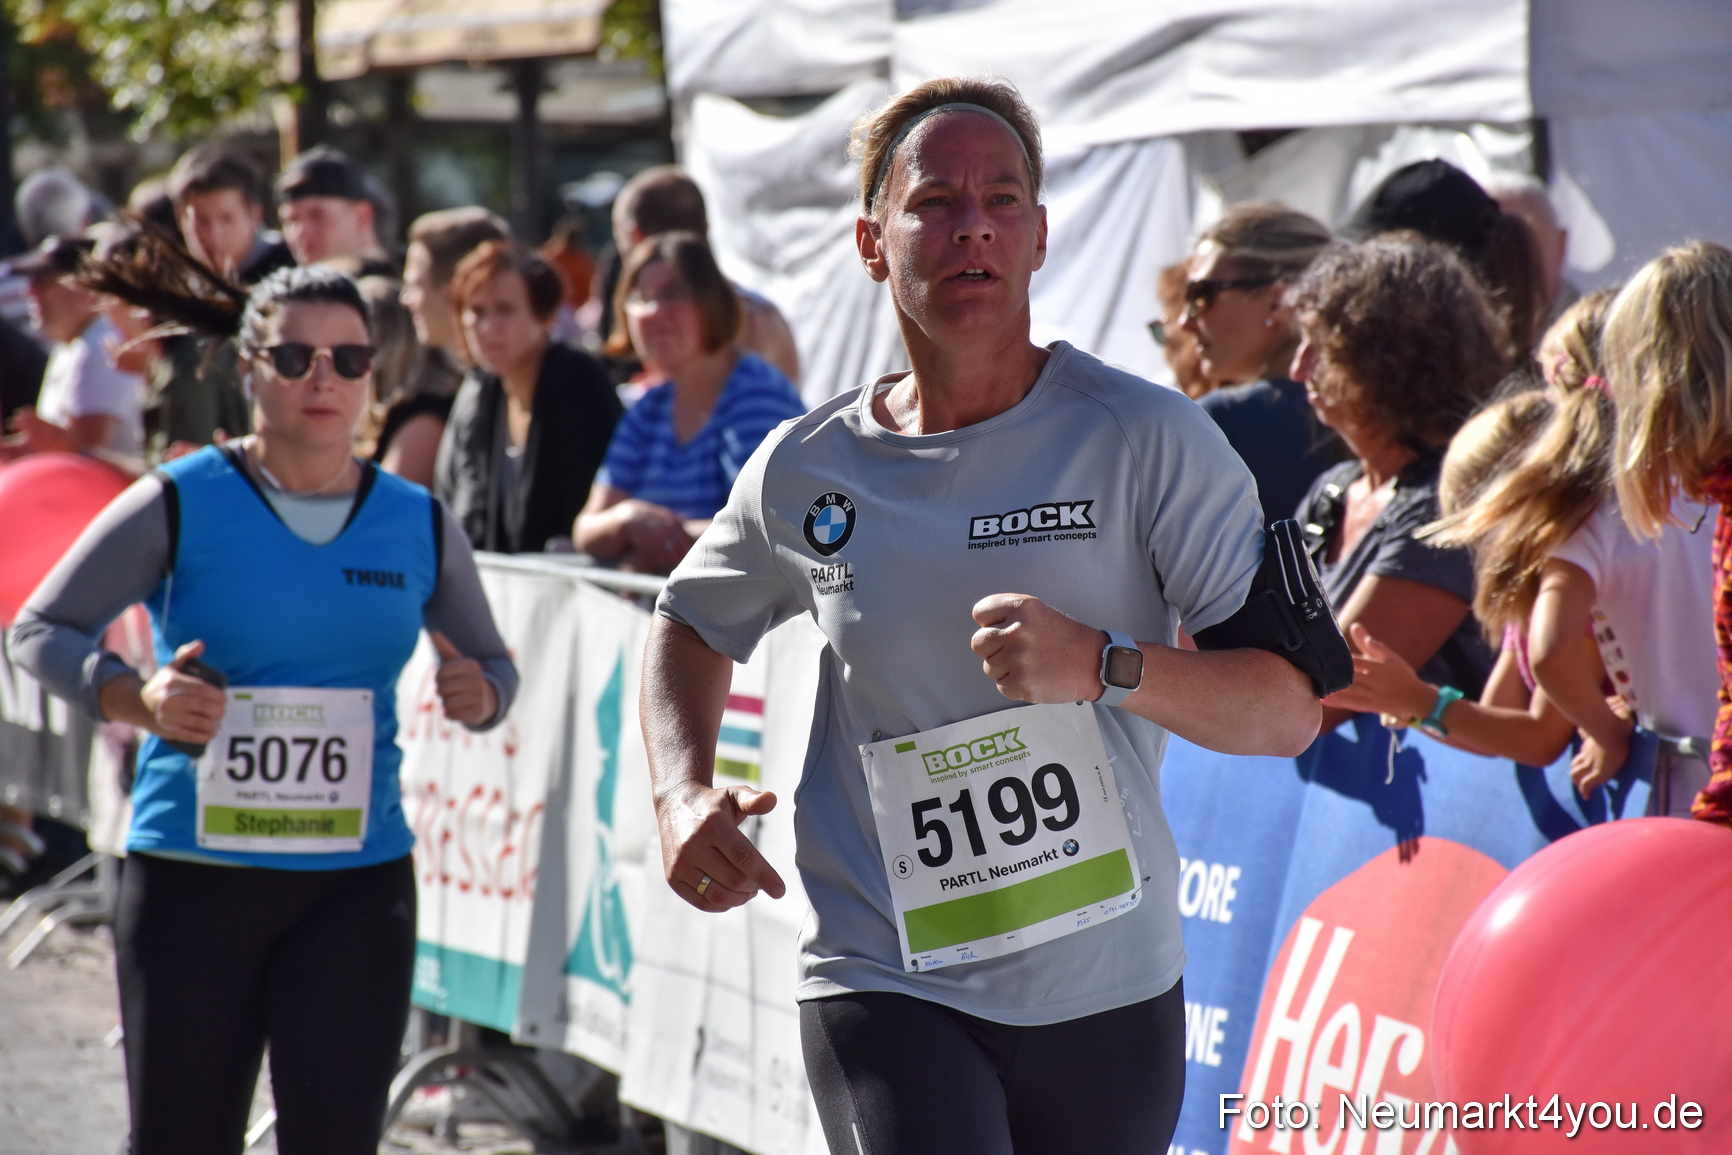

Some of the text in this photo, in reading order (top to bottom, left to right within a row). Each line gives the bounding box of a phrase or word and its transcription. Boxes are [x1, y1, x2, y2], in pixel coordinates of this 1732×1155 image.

[810, 494, 854, 517] BMW
[969, 500, 1097, 540] BOCK
[968, 531, 1097, 550] inspired by smart concepts
[342, 568, 406, 590] THULE
[811, 562, 854, 584] PARTL
[226, 735, 347, 783] 5076
[921, 726, 1028, 776] BOCK
[930, 751, 1031, 784] inspired by smart concepts
[235, 812, 336, 836] Stephanie
[911, 763, 1080, 868] 5199
[899, 861, 908, 874] S
[939, 848, 1059, 891] PARTL Neumarkt
[1178, 857, 1242, 924] ORE
